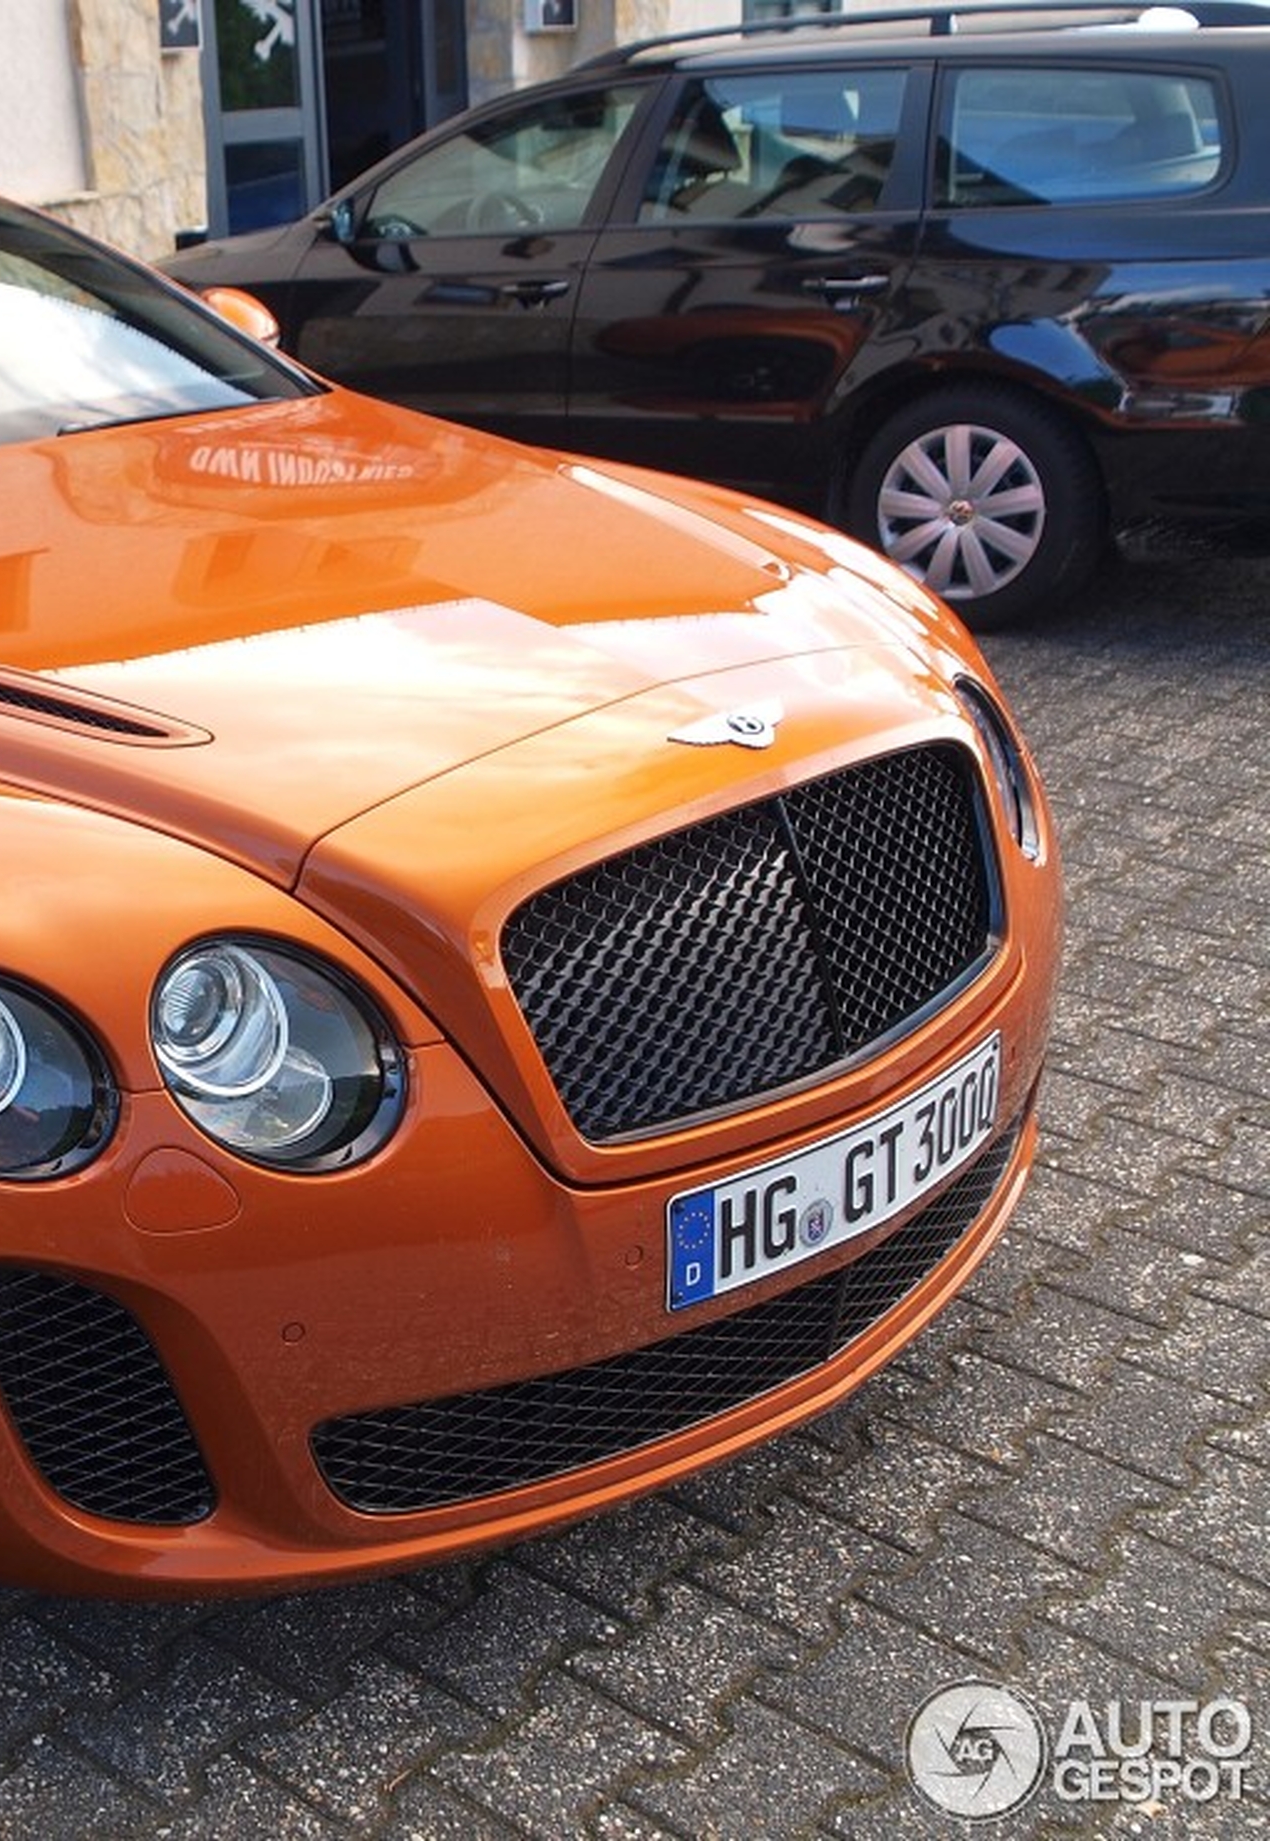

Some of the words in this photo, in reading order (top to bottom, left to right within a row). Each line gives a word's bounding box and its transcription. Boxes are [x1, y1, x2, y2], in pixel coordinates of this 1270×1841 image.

[720, 1175, 797, 1278] HG
[845, 1122, 903, 1224] GT
[914, 1055, 995, 1183] 3000
[686, 1262, 701, 1287] D
